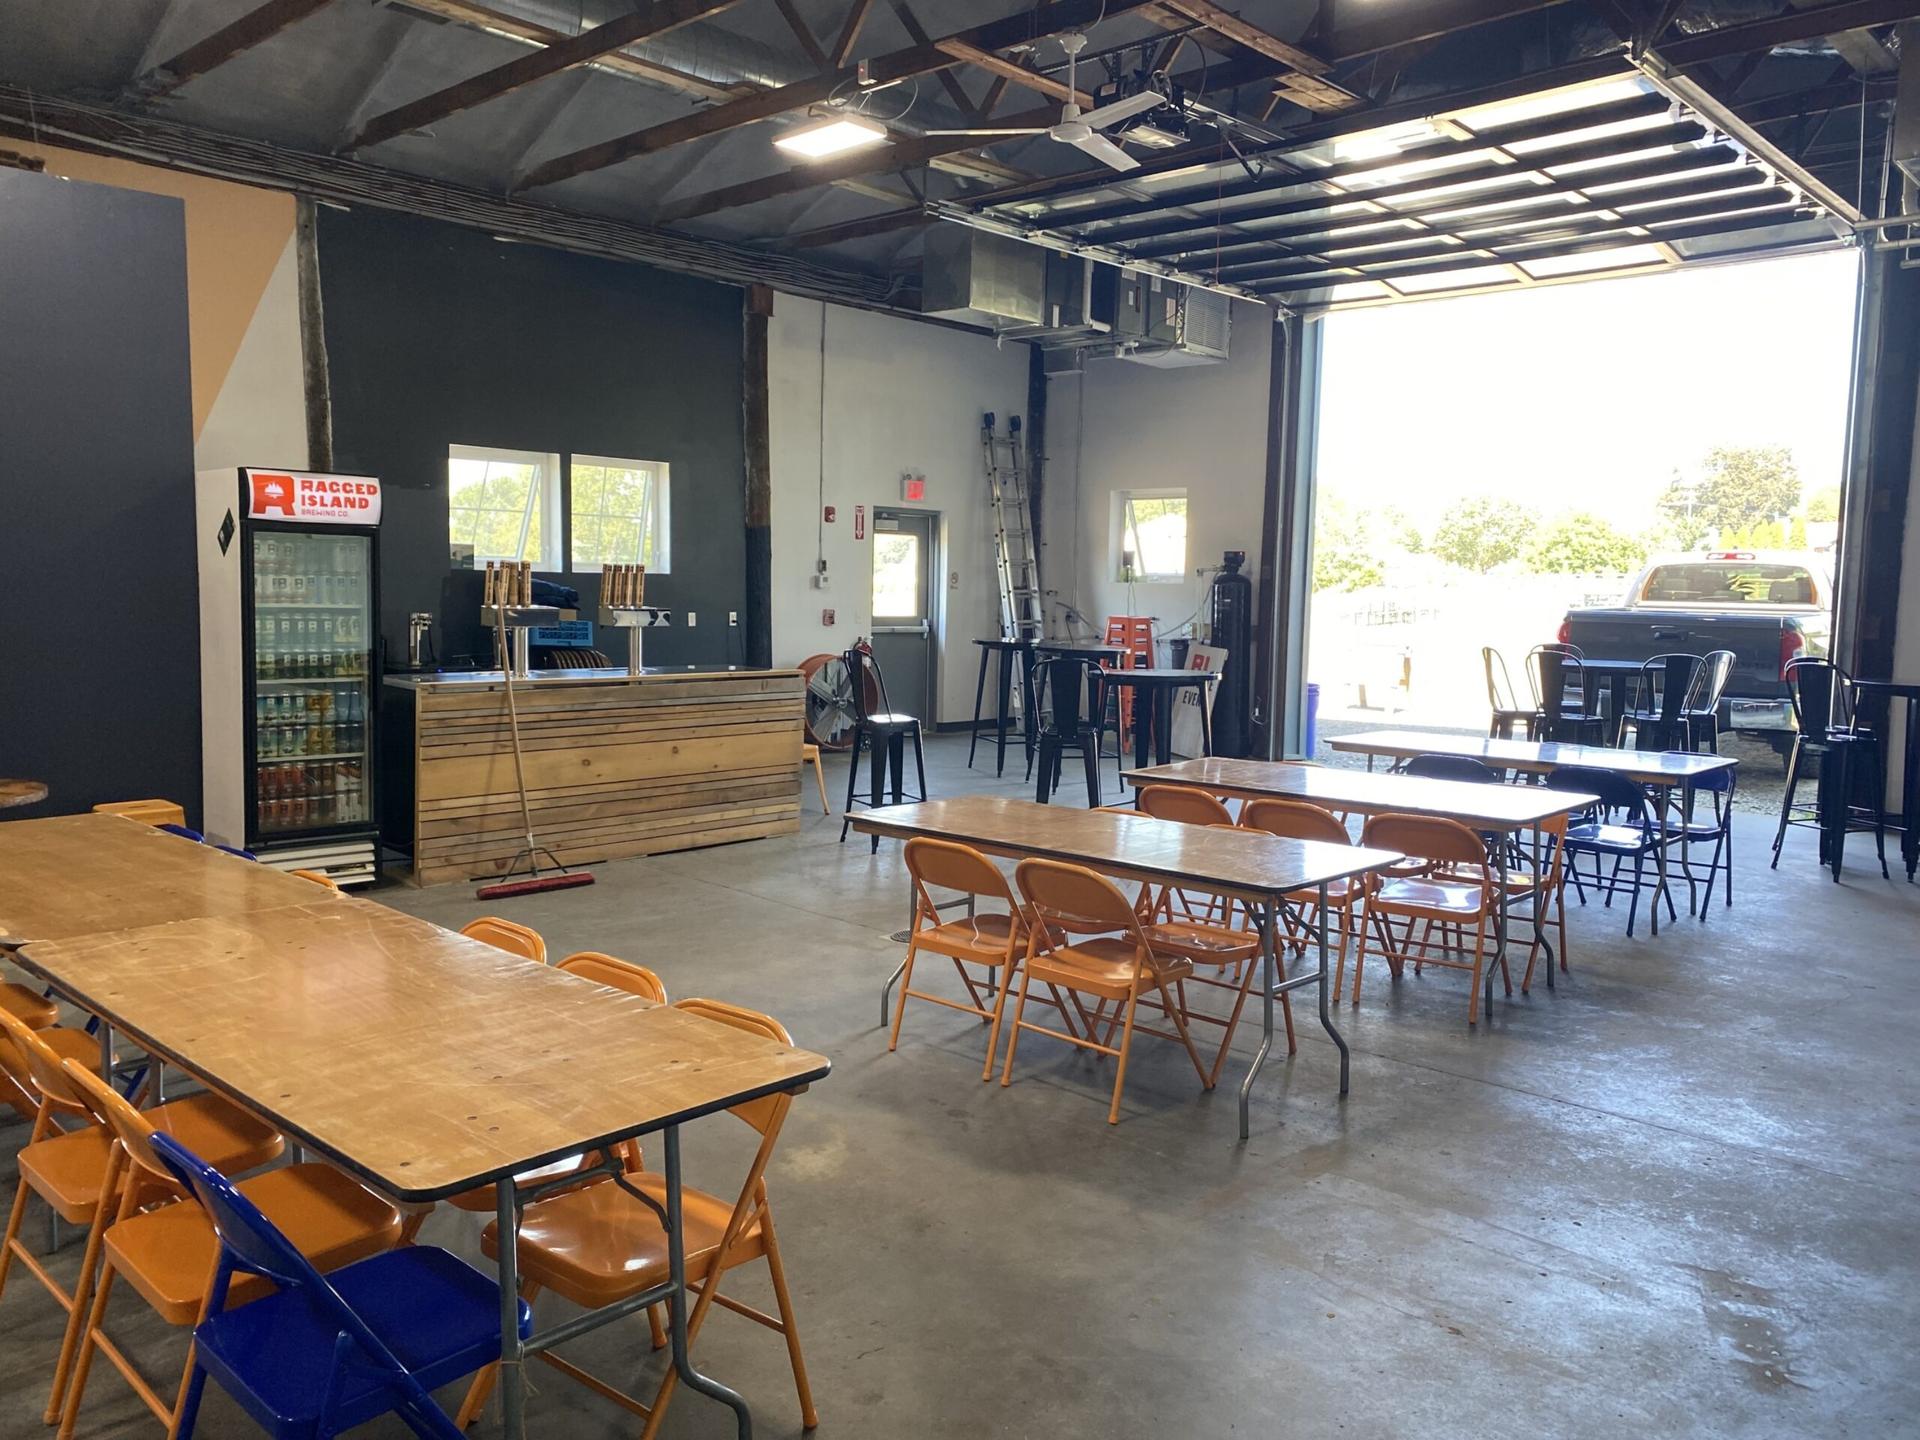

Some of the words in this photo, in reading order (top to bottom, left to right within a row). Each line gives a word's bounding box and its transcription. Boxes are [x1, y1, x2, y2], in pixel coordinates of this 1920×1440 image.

[301, 480, 378, 496] RAGGED
[301, 495, 370, 509] ISLAND
[301, 508, 336, 517] BREWING
